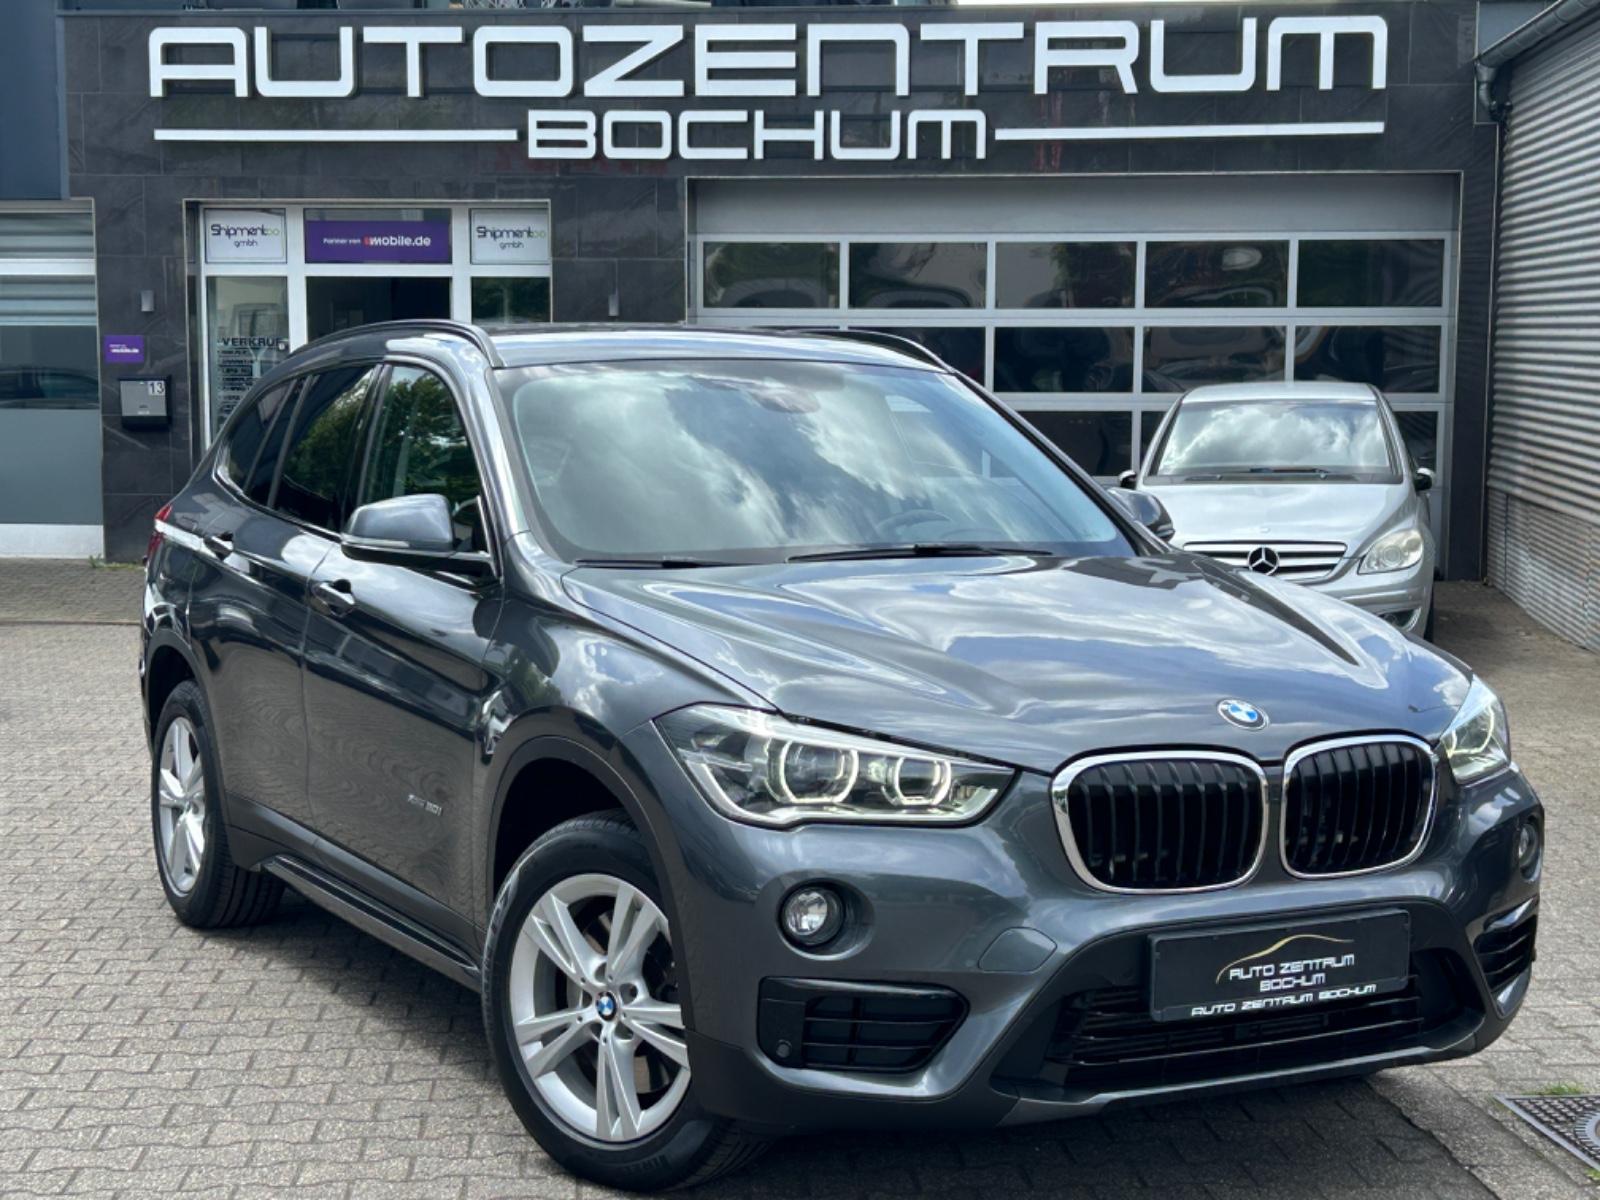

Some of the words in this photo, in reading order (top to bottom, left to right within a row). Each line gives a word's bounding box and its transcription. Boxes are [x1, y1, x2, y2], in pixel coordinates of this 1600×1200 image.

[148, 15, 1388, 99] AUTOZENTRUM
[527, 109, 987, 161] BOCHUM
[364, 235, 431, 247] mobile.de
[150, 382, 165, 394] 13
[1229, 964, 1276, 981] AUTO
[1279, 954, 1355, 975] ZENTRUM
[1260, 973, 1326, 992] BOCHUM
[1191, 1002, 1236, 1017] AUTO
[1240, 992, 1314, 1011] ZENTRUM
[1318, 983, 1377, 1000] BOCHUM
